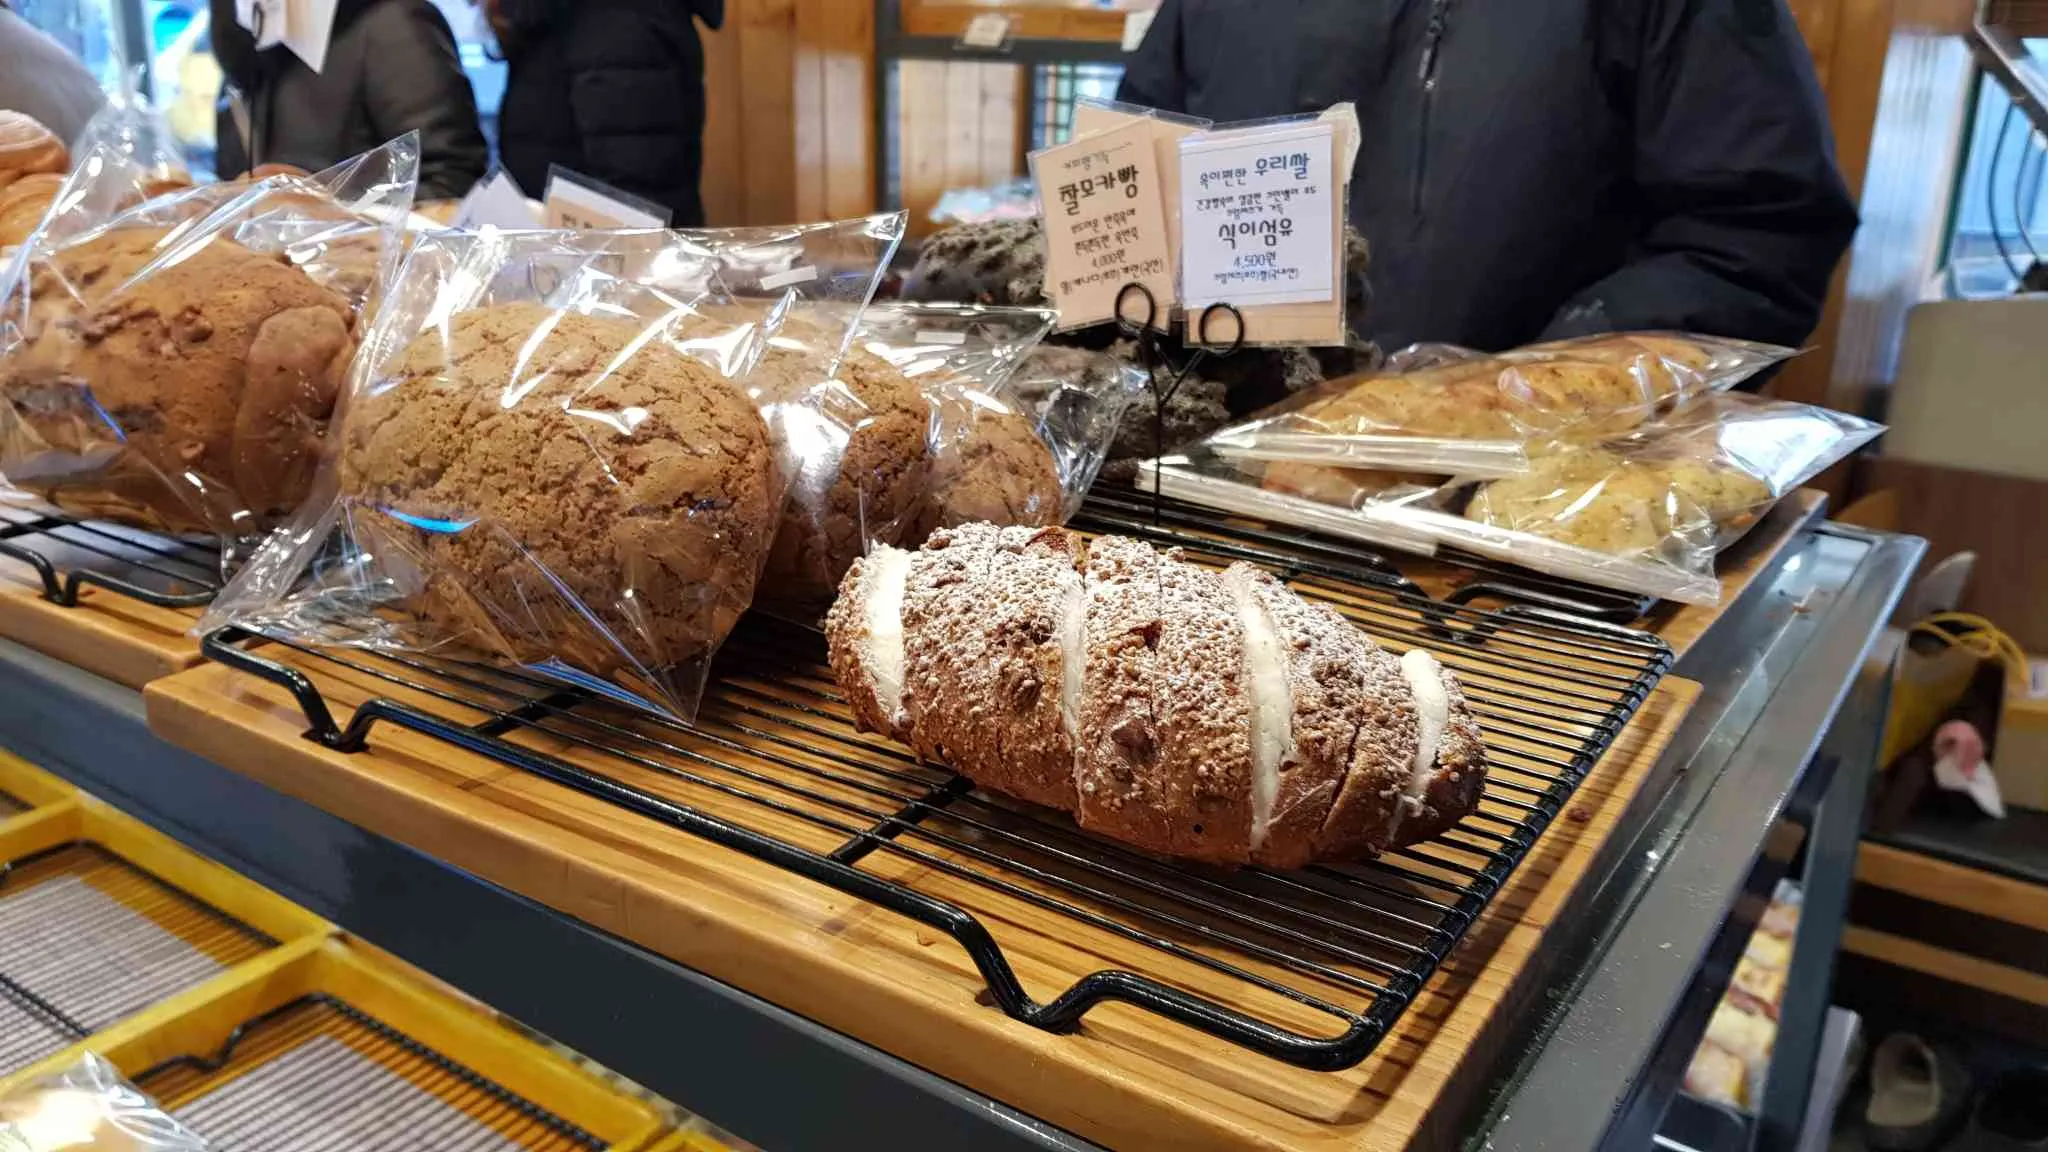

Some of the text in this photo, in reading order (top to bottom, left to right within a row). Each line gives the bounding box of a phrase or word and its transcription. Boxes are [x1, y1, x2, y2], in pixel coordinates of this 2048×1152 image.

[1254, 153, 1311, 180] 우리쌀
[1218, 218, 1294, 250] 식이섬유
[1233, 252, 1277, 270] 4,500원
